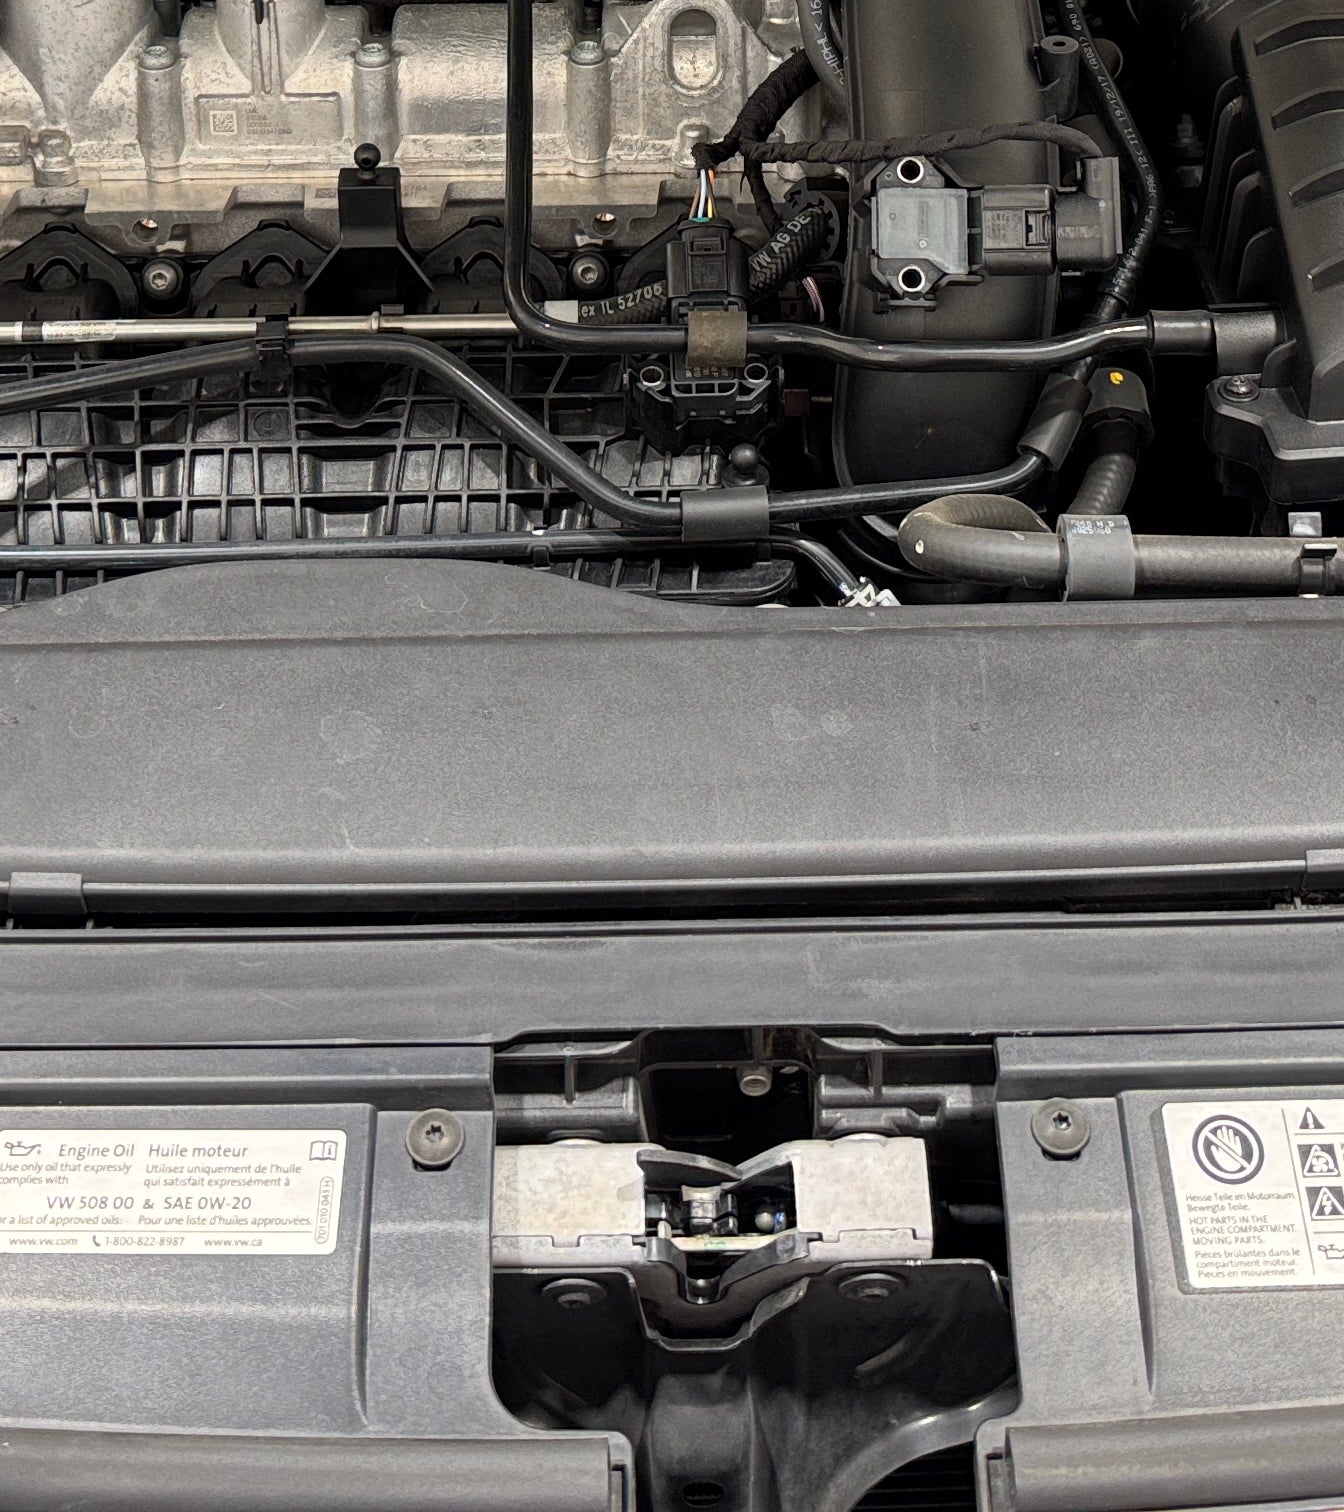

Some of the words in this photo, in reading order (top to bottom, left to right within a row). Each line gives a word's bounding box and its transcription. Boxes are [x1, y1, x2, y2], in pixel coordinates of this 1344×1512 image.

[750, 252, 772, 273] VW
[770, 233, 792, 255] AG
[617, 284, 664, 311] 52706
[58, 1143, 110, 1160] Engine
[113, 1144, 135, 1158] Oil
[148, 1144, 188, 1158] Huile
[192, 1145, 248, 1158] moteur
[0, 1163, 20, 1172] Use
[20, 1161, 42, 1174] only
[45, 1162, 57, 1172] oil
[60, 1162, 81, 1172] that
[83, 1162, 132, 1174] expressly
[146, 1164, 184, 1174] Utilisez
[186, 1164, 252, 1176] uniquement
[254, 1164, 268, 1174] de
[270, 1164, 302, 1174] l'huile
[45, 1174, 69, 1185] with
[144, 1177, 161, 1188] qui
[163, 1176, 206, 1186] satisfait
[207, 1176, 282, 1188] expressément
[284, 1176, 291, 1186] à
[46, 1196, 76, 1210] VW
[79, 1196, 109, 1210] 508
[113, 1196, 135, 1210] 00
[142, 1198, 154, 1210] &
[163, 1196, 194, 1210] SAE
[198, 1196, 252, 1210] 0W-20
[8, 1216, 16, 1225] a
[18, 1215, 34, 1225] list
[36, 1214, 48, 1225] of
[49, 1215, 99, 1227] approved
[138, 1215, 162, 1226] Pour
[164, 1216, 184, 1226] une
[186, 1215, 208, 1226] liste
[209, 1214, 249, 1226] d'huiles
[1189, 1216, 1208, 1225] HOT
[1210, 1216, 1237, 1224] PARTS
[1239, 1216, 1250, 1224] IN
[1251, 1215, 1269, 1224] THE
[1190, 1226, 1226, 1235] ENGINE
[9, 1238, 78, 1246] www.vw.com
[105, 1236, 185, 1246] 1-800-822-8987
[204, 1237, 263, 1246] www.vw.ca
[1192, 1236, 1232, 1245] MOVING
[1268, 1248, 1290, 1257] dans
